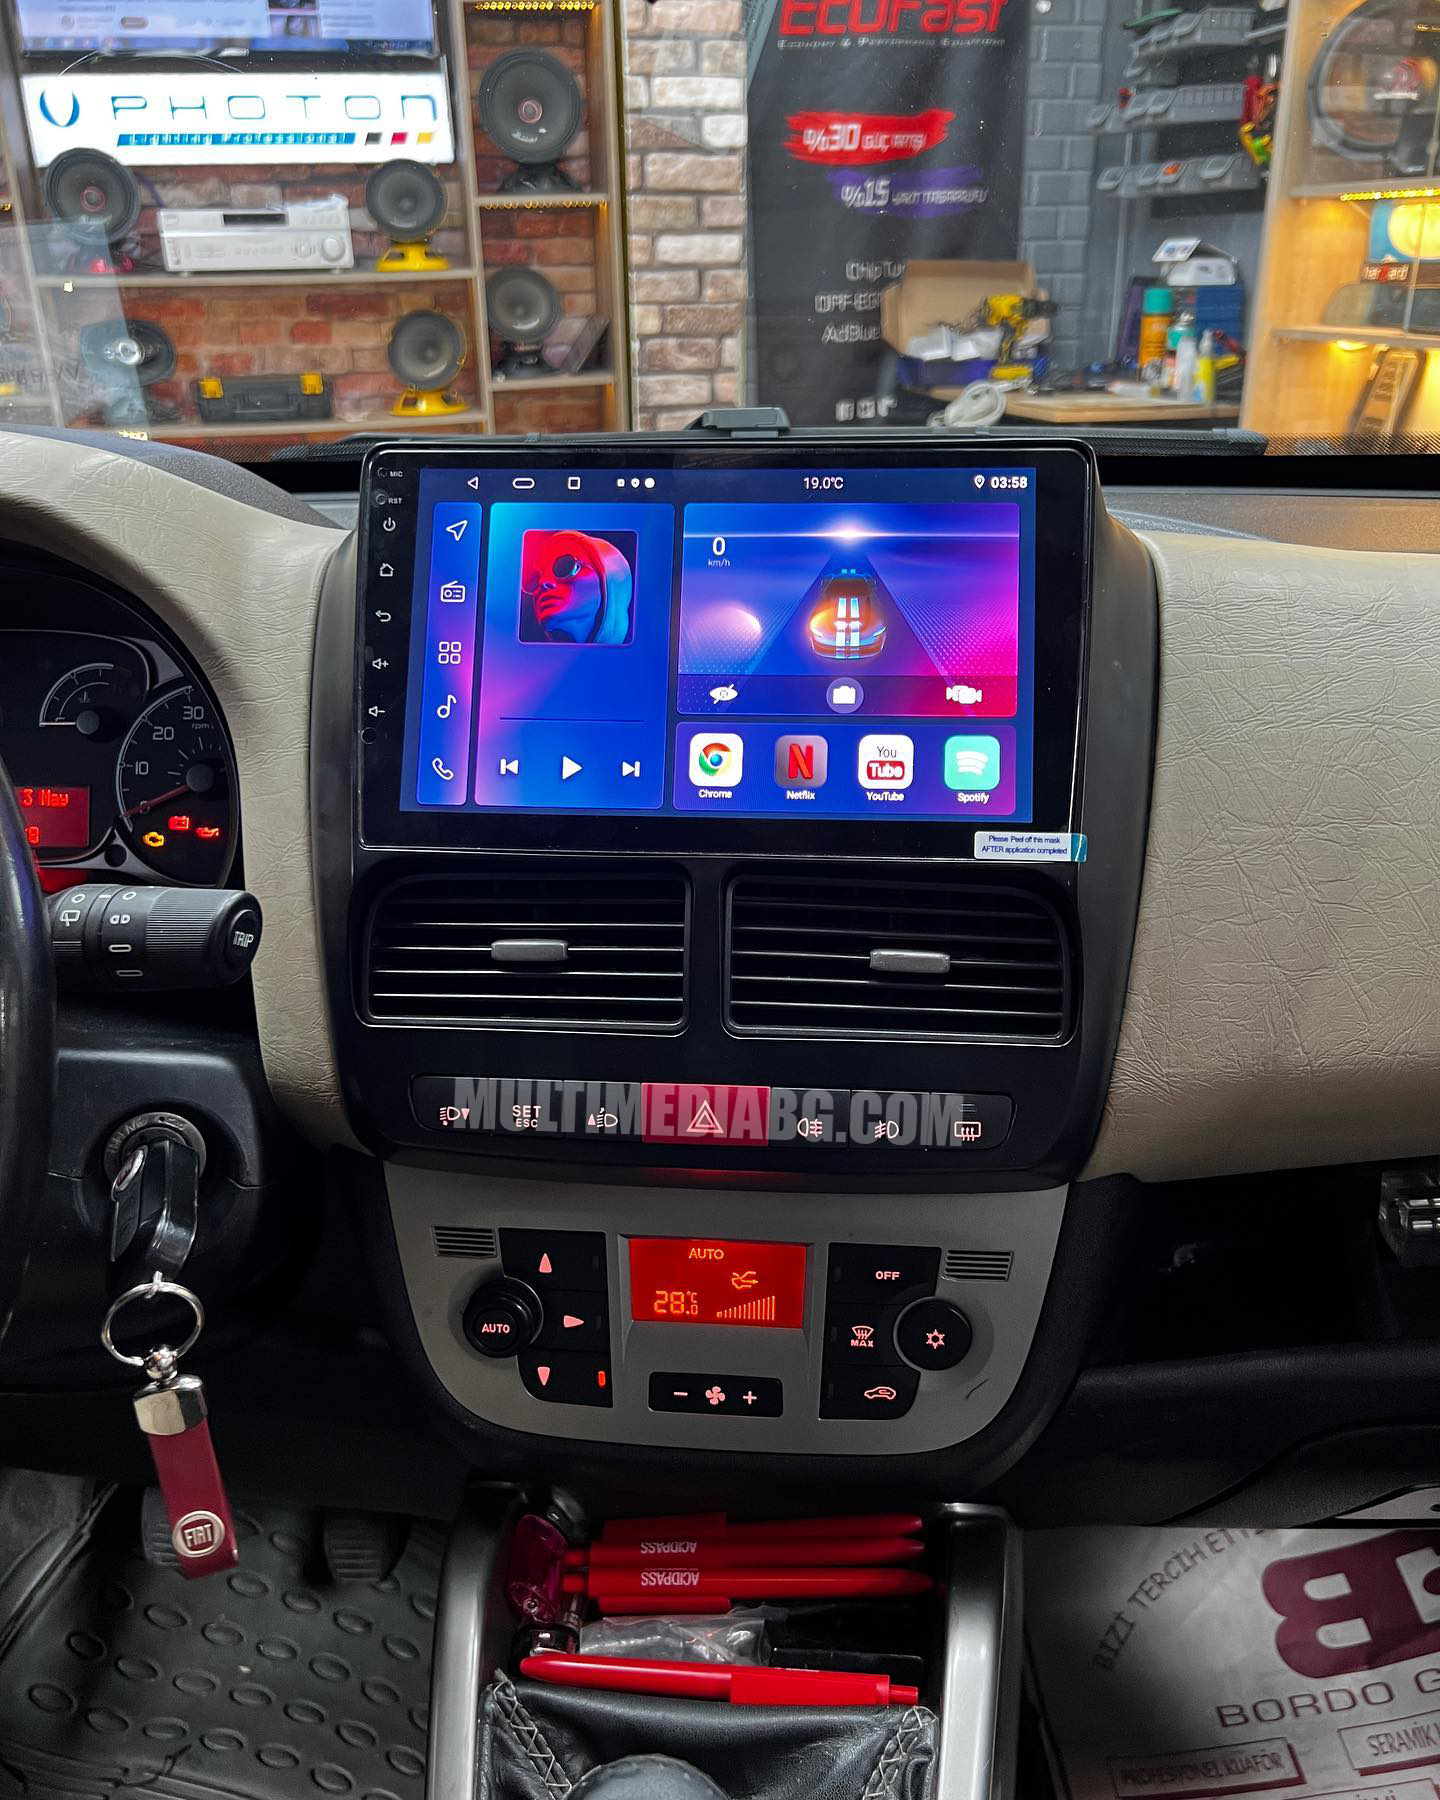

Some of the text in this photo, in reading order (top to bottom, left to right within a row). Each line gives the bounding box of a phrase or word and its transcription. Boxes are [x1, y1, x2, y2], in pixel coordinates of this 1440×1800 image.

[110, 94, 438, 122] PHOTON
[803, 121, 861, 153] %30
[840, 176, 891, 208] %15
[803, 476, 844, 490] 19.0°C
[990, 476, 1028, 490] 03:58
[712, 536, 726, 556] 0
[708, 558, 731, 568] km/h
[183, 705, 205, 720] 30
[191, 722, 210, 730] rpm
[152, 726, 175, 741] 20
[876, 744, 898, 759] You
[135, 761, 149, 775] 10
[868, 761, 903, 778] Tube
[23, 788, 69, 807] 3 May
[698, 788, 733, 799] Chrome
[786, 789, 816, 801] Netflix
[866, 790, 905, 802] YouTube
[957, 792, 990, 805] Spotify
[988, 835, 1009, 843] Please
[1033, 836, 1043, 844] this
[981, 845, 1068, 855] AFTER application completed
[233, 930, 254, 948] TRIP
[512, 1105, 542, 1119] SET
[515, 1118, 539, 1129] ESC
[688, 1247, 725, 1260] AUTO
[875, 1270, 901, 1281] OFF
[481, 1323, 511, 1334] AUTO
[850, 1338, 874, 1348] MAX
[183, 1522, 213, 1548] FIAT
[640, 1541, 697, 1554] ACIDPASS
[640, 1571, 700, 1586] ACIDPASS
[1216, 1681, 1396, 1728] BORDO
[1366, 1721, 1437, 1756] SERAMİK
